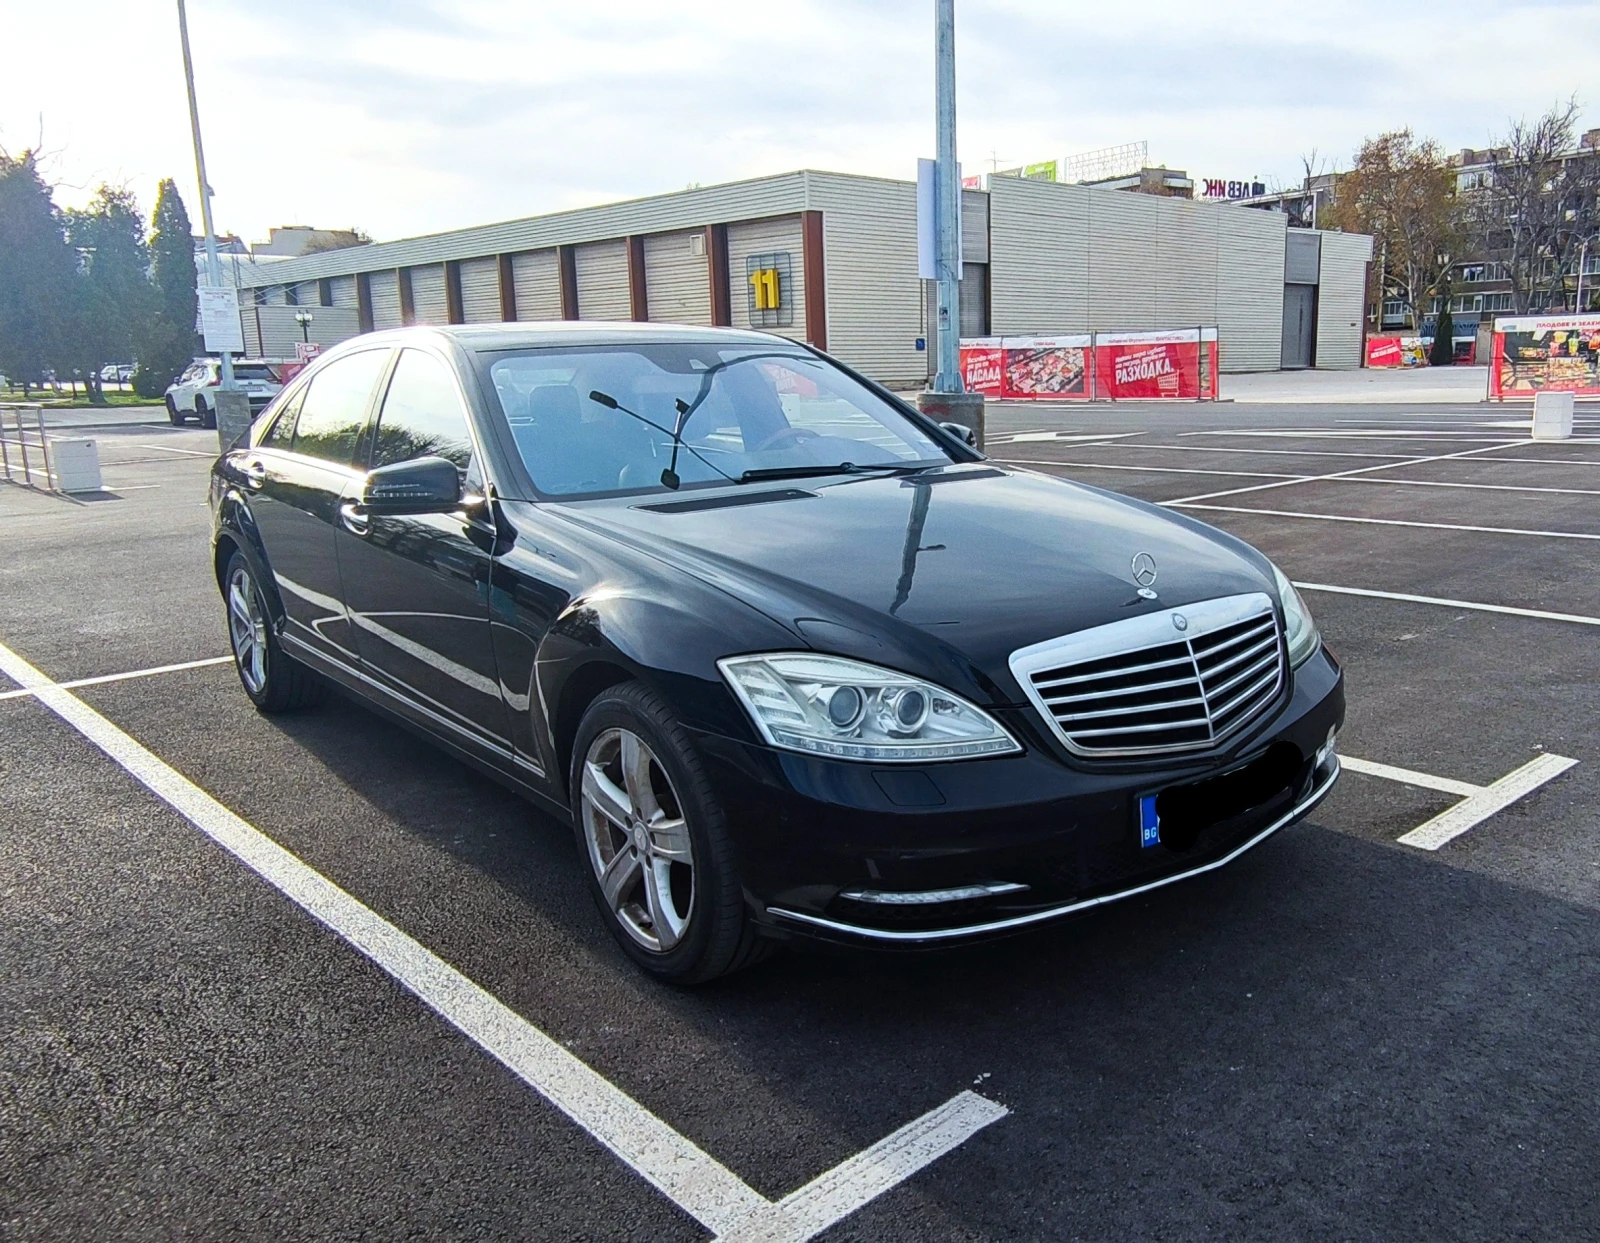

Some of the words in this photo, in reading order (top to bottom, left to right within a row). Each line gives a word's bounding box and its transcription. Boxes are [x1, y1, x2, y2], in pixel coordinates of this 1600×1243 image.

[749, 269, 780, 309] 11
[1115, 358, 1175, 385] РАЗХОДКА.
[1145, 826, 1157, 841] BG
